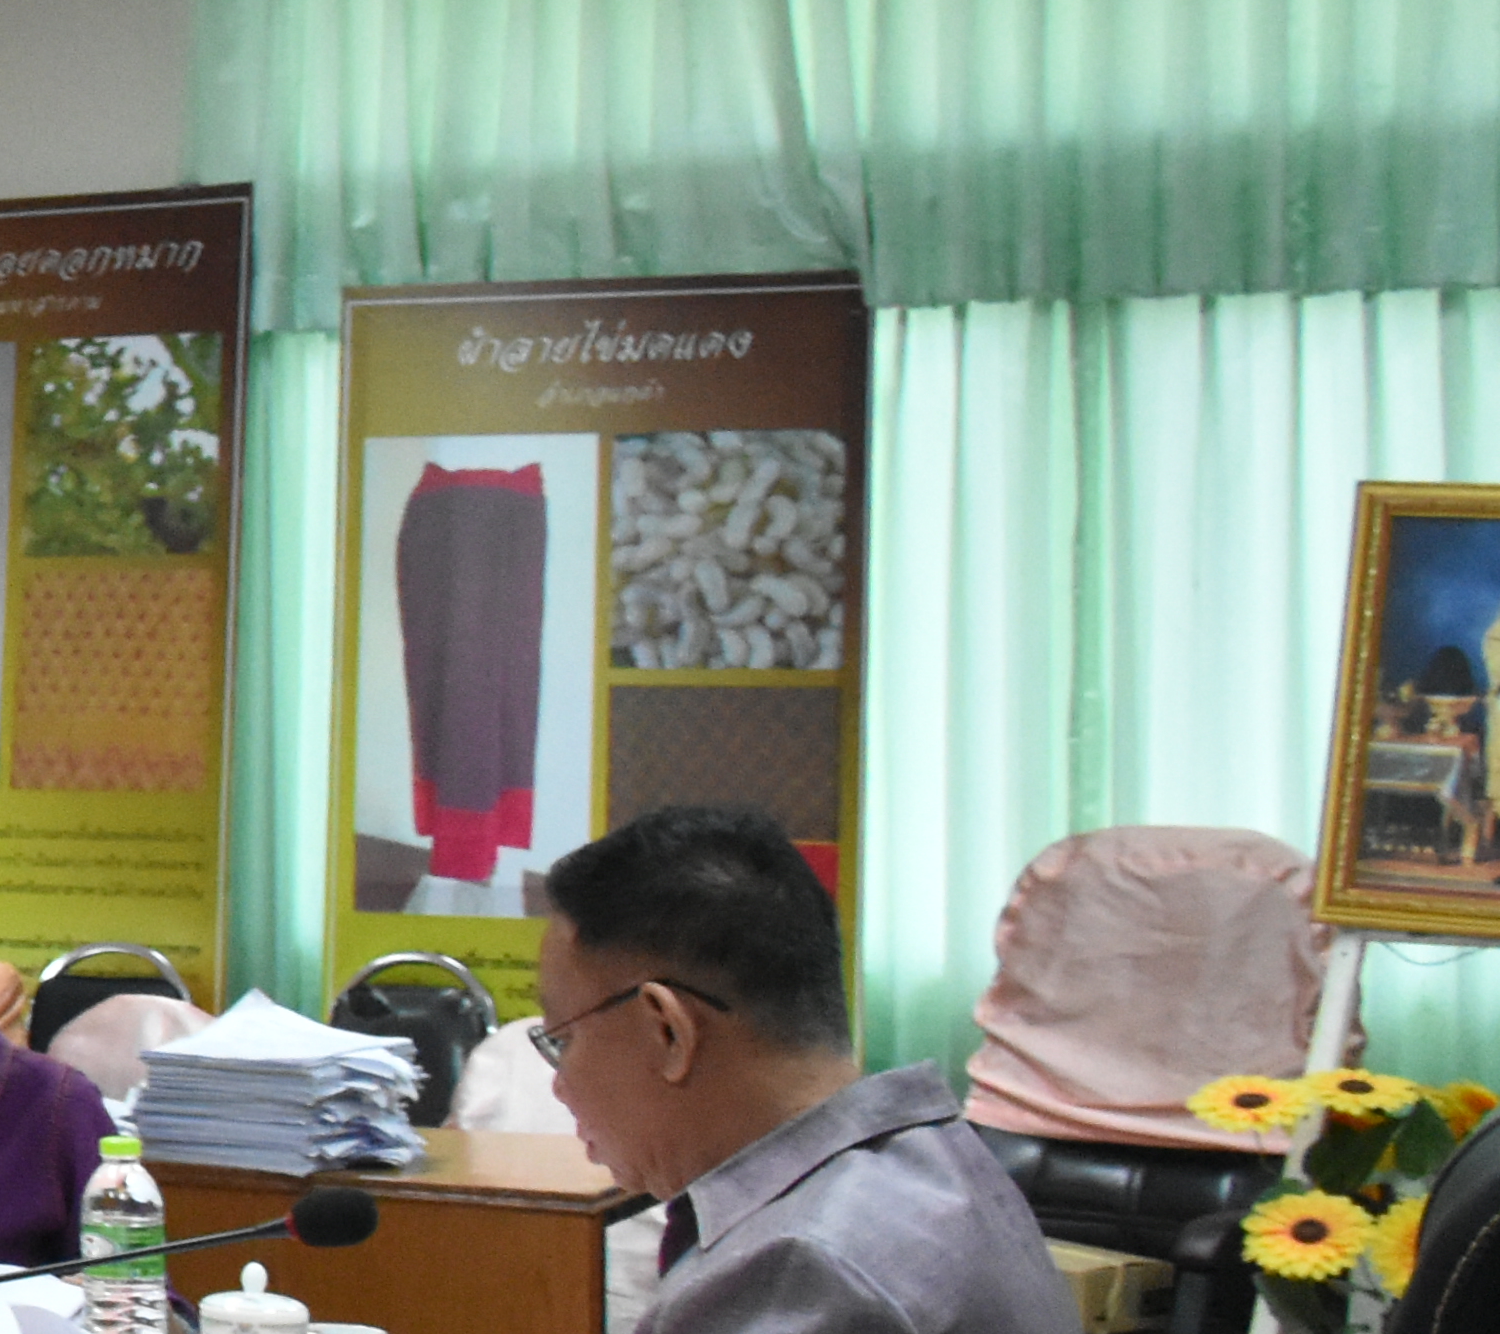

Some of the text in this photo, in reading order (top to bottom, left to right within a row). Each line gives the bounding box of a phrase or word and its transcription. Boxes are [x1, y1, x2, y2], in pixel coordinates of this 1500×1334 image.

[457, 319, 754, 372] ผ้าลายไข่มดแดง
